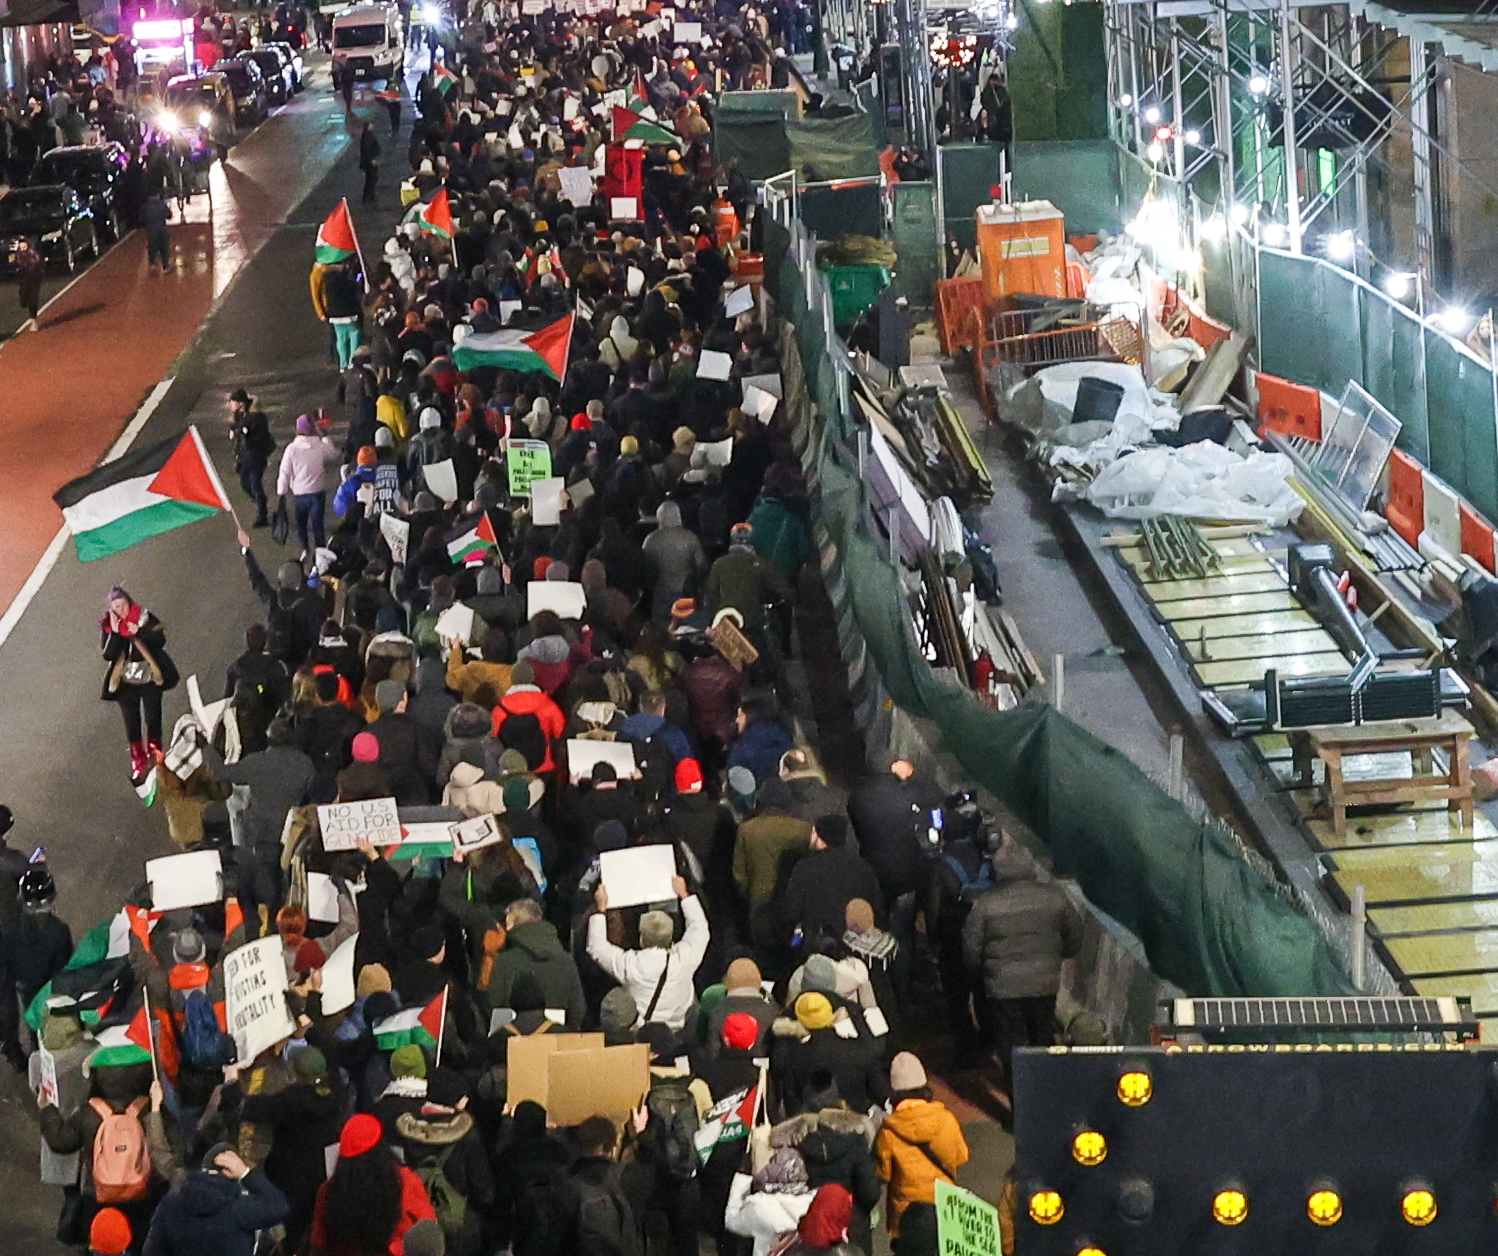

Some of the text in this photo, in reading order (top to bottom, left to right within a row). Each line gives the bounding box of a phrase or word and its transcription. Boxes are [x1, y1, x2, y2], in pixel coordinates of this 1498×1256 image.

[328, 805, 351, 820] NO
[325, 813, 394, 833] AID FOR
[241, 947, 262, 969] FOR
